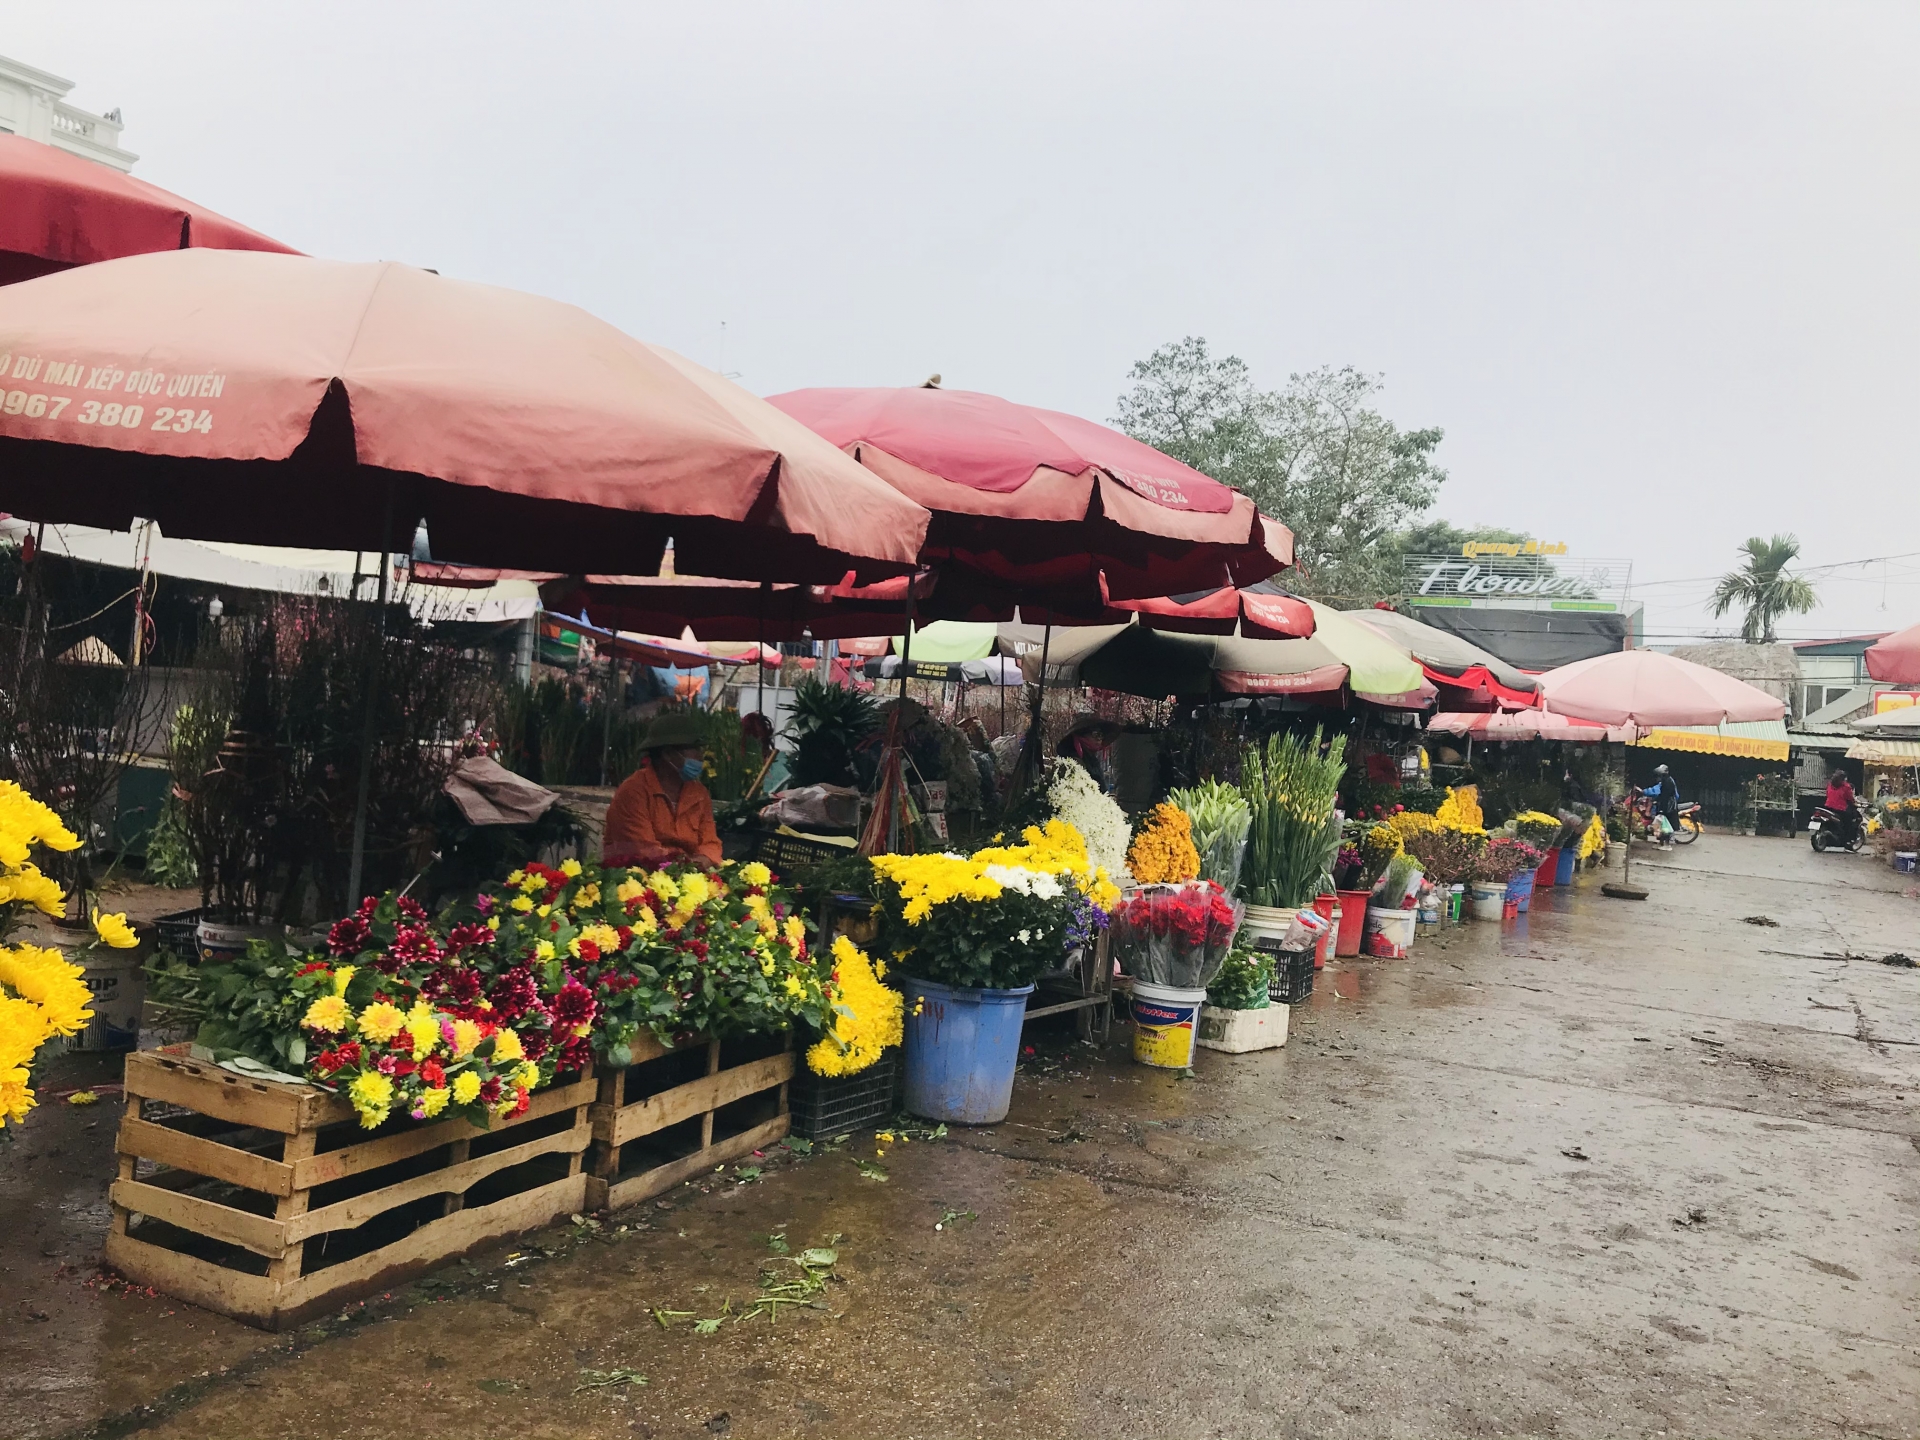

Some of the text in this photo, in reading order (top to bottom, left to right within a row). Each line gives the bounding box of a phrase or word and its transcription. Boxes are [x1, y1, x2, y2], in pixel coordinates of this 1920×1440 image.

[12, 354, 43, 381] DÙ
[42, 359, 85, 387] MÁI
[84, 363, 125, 391] XẾP
[124, 367, 165, 399] ĐỘC
[77, 400, 144, 428] 380
[151, 407, 213, 434] 234
[1160, 489, 1188, 503] 234
[1462, 540, 1568, 559] Quang Minh
[1293, 677, 1312, 686] 234
